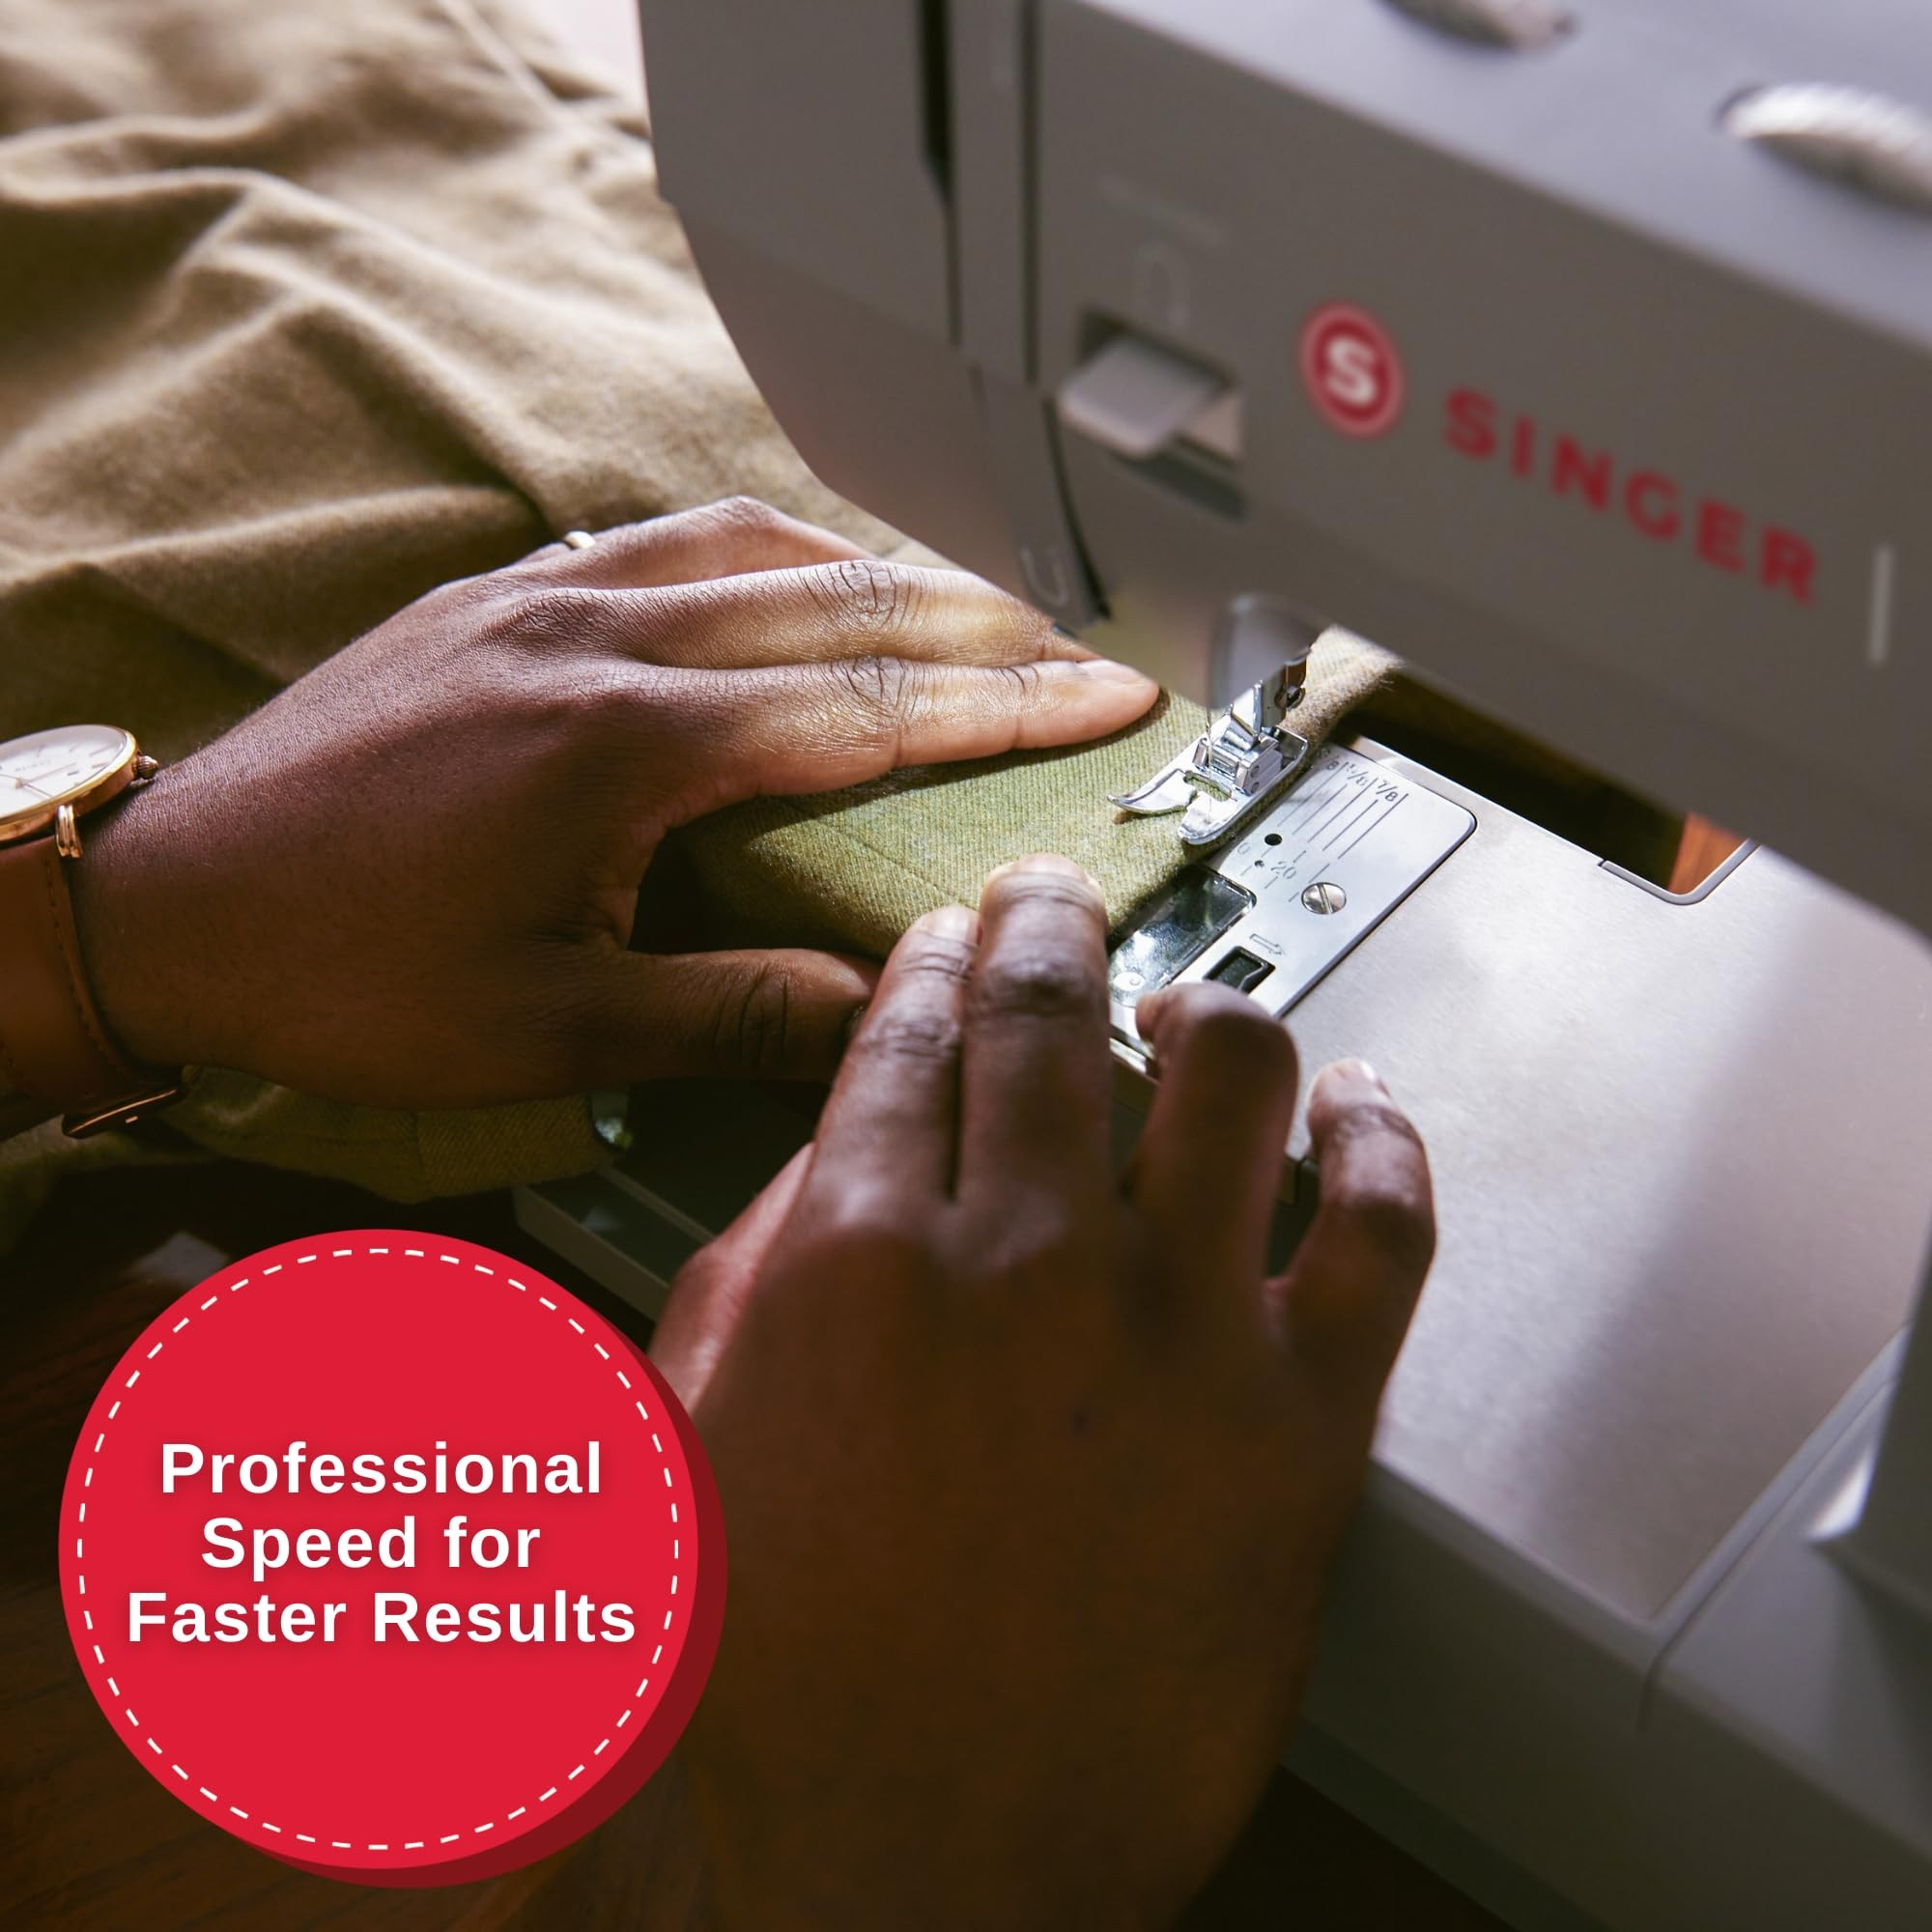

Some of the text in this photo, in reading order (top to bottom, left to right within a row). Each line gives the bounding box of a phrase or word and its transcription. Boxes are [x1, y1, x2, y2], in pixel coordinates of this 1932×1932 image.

[1323, 335, 1817, 605] S SINGER
[1376, 780, 1399, 802] 7/8
[1270, 861, 1296, 879] 20
